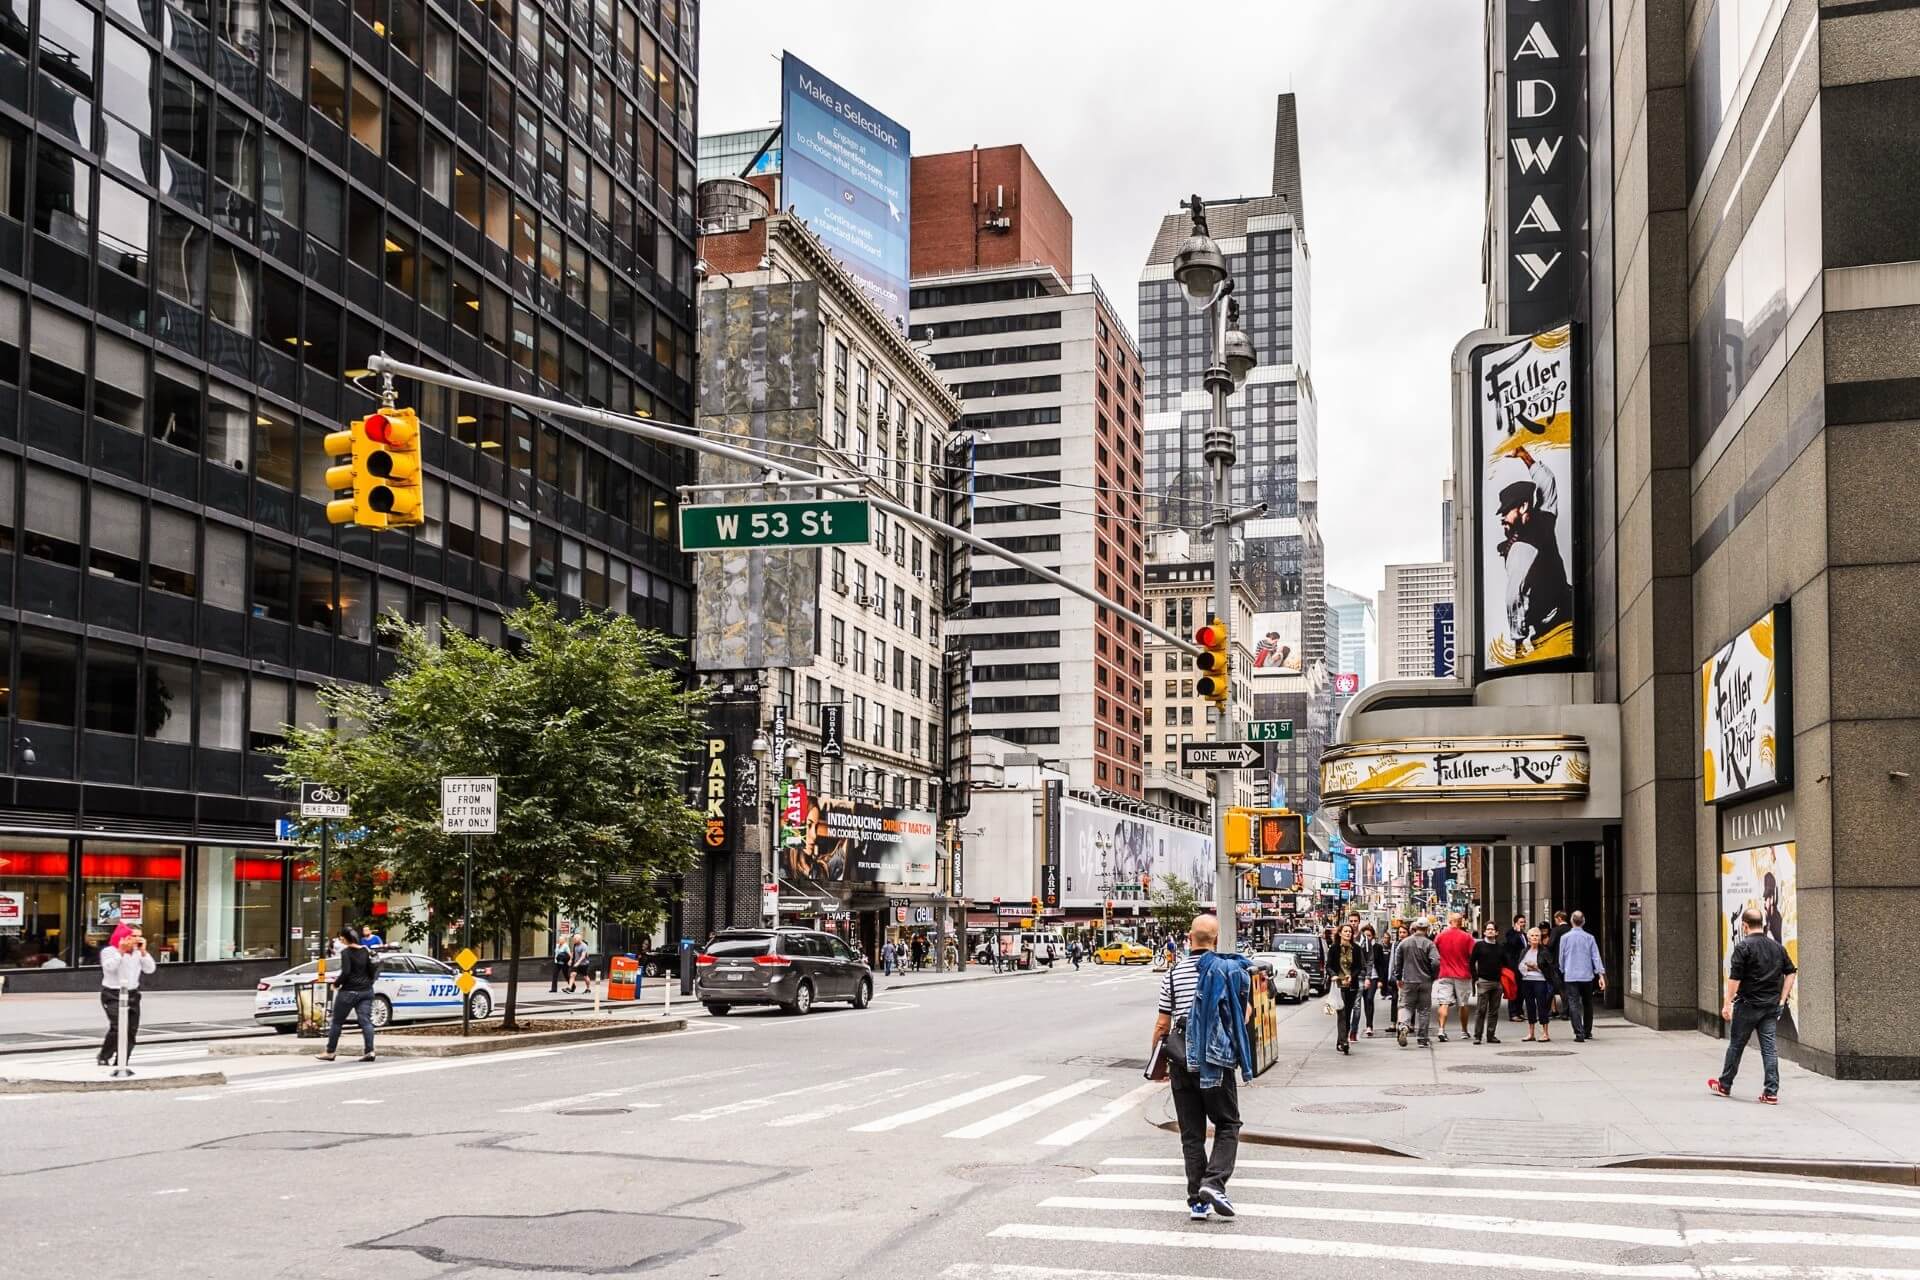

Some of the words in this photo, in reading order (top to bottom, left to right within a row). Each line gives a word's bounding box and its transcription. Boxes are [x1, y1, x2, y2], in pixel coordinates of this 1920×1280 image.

[799, 74, 832, 108] Make
[835, 101, 842, 114] a
[843, 104, 898, 149] Selection:
[797, 131, 806, 144] to
[844, 191, 854, 201] or
[1485, 341, 1560, 430] Fiddler
[1504, 380, 1567, 437] Roof
[716, 514, 739, 540] W
[751, 512, 789, 539] 53
[801, 510, 833, 537] St
[1714, 640, 1752, 771] Fiddler
[775, 708, 785, 735] FLASH
[1251, 723, 1260, 739] W
[1264, 723, 1277, 739] 53
[1280, 722, 1290, 731] ST
[1193, 750, 1216, 761] ONE
[1228, 750, 1252, 761] WAY
[1724, 708, 1757, 790] Roof
[1433, 752, 1490, 785] Fiddler
[1511, 754, 1562, 784] Roof
[708, 739, 727, 818] PARK
[447, 784, 467, 793] LEFT
[471, 784, 492, 793] TURN
[458, 795, 481, 804] FROM
[304, 805, 322, 814] BIKE
[327, 805, 347, 814] PATH
[446, 807, 467, 816] LEFT
[470, 807, 491, 816] TURN
[448, 819, 464, 828] BAY
[468, 819, 489, 828] ONLY
[828, 813, 882, 830] INTRODUCING
[908, 822, 931, 835] MATCH
[828, 827, 836, 838] NO
[861, 831, 872, 841] JUST
[1048, 865, 1056, 895] PARK
[890, 899, 909, 907] 1674
[429, 984, 461, 997] NYPD
